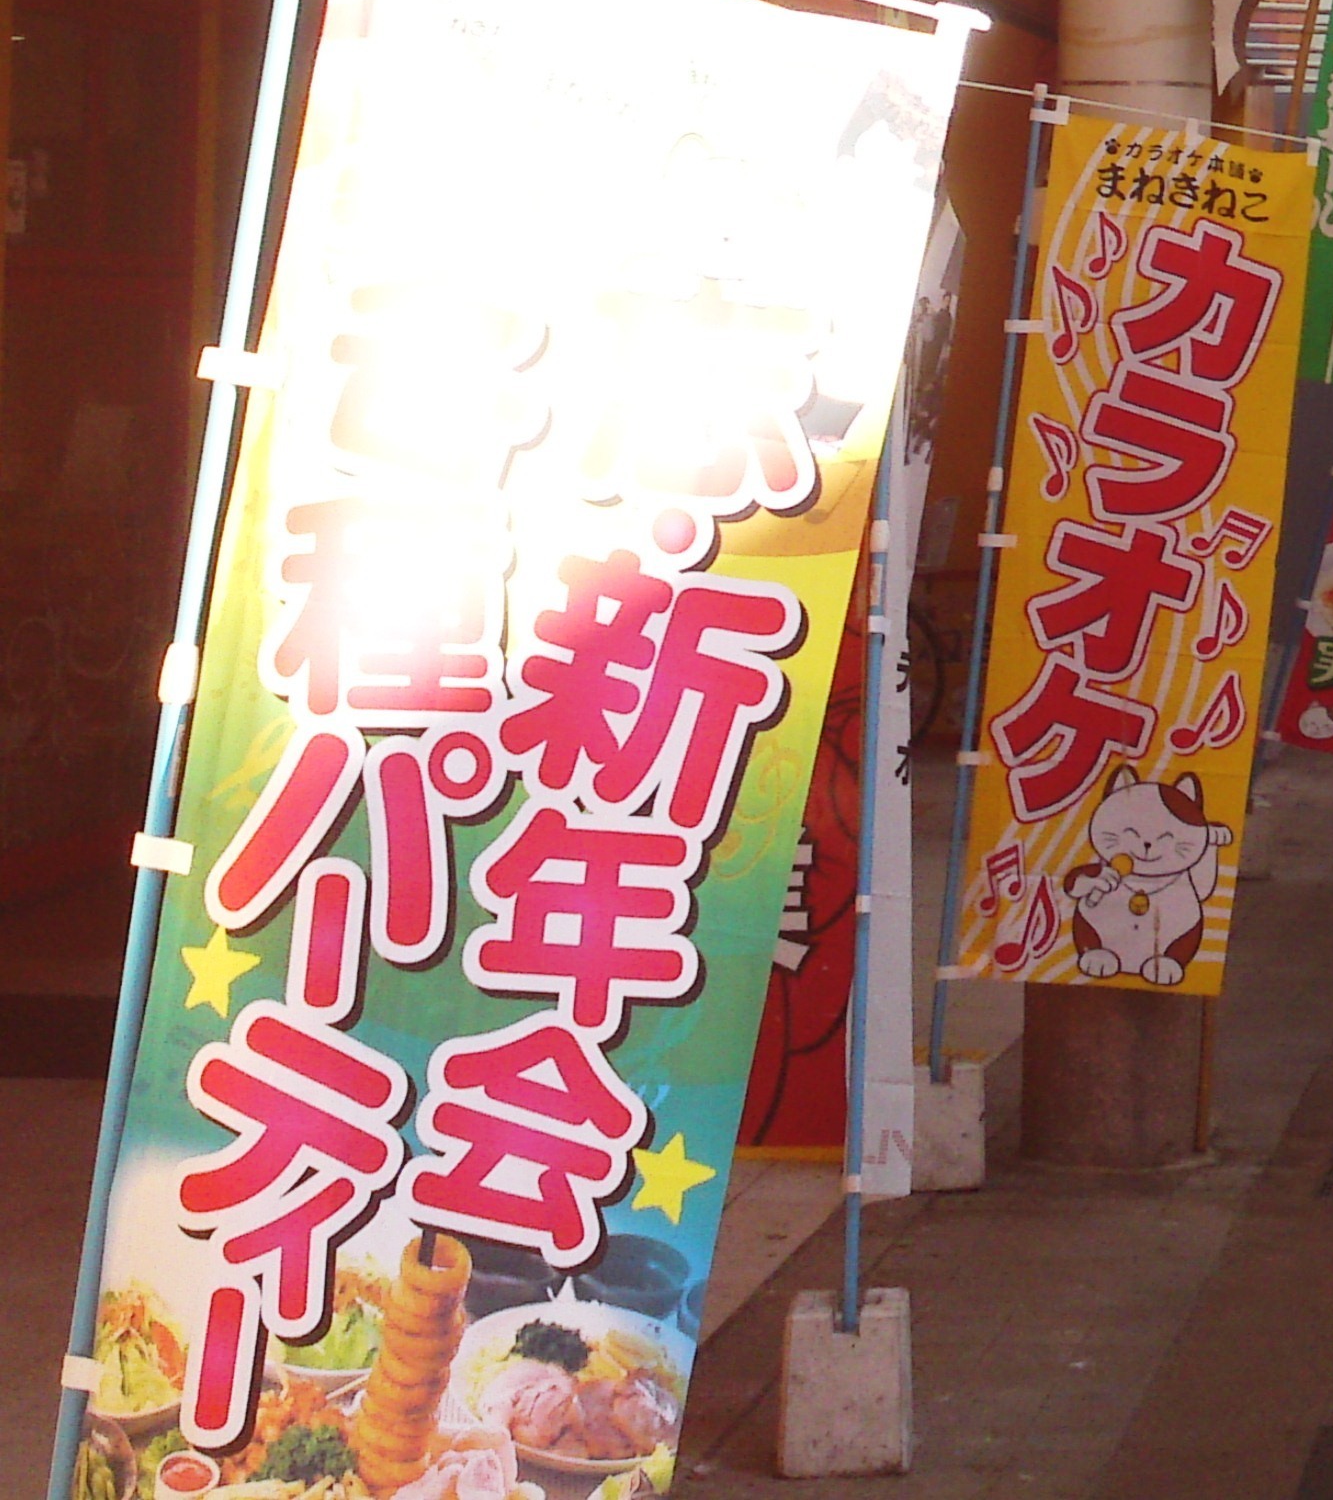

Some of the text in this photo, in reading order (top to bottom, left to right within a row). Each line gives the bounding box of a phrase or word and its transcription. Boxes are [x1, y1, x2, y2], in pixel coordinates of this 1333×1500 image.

[1095, 163, 1271, 222] まねきねこ
[991, 218, 1284, 824] カラオケ
